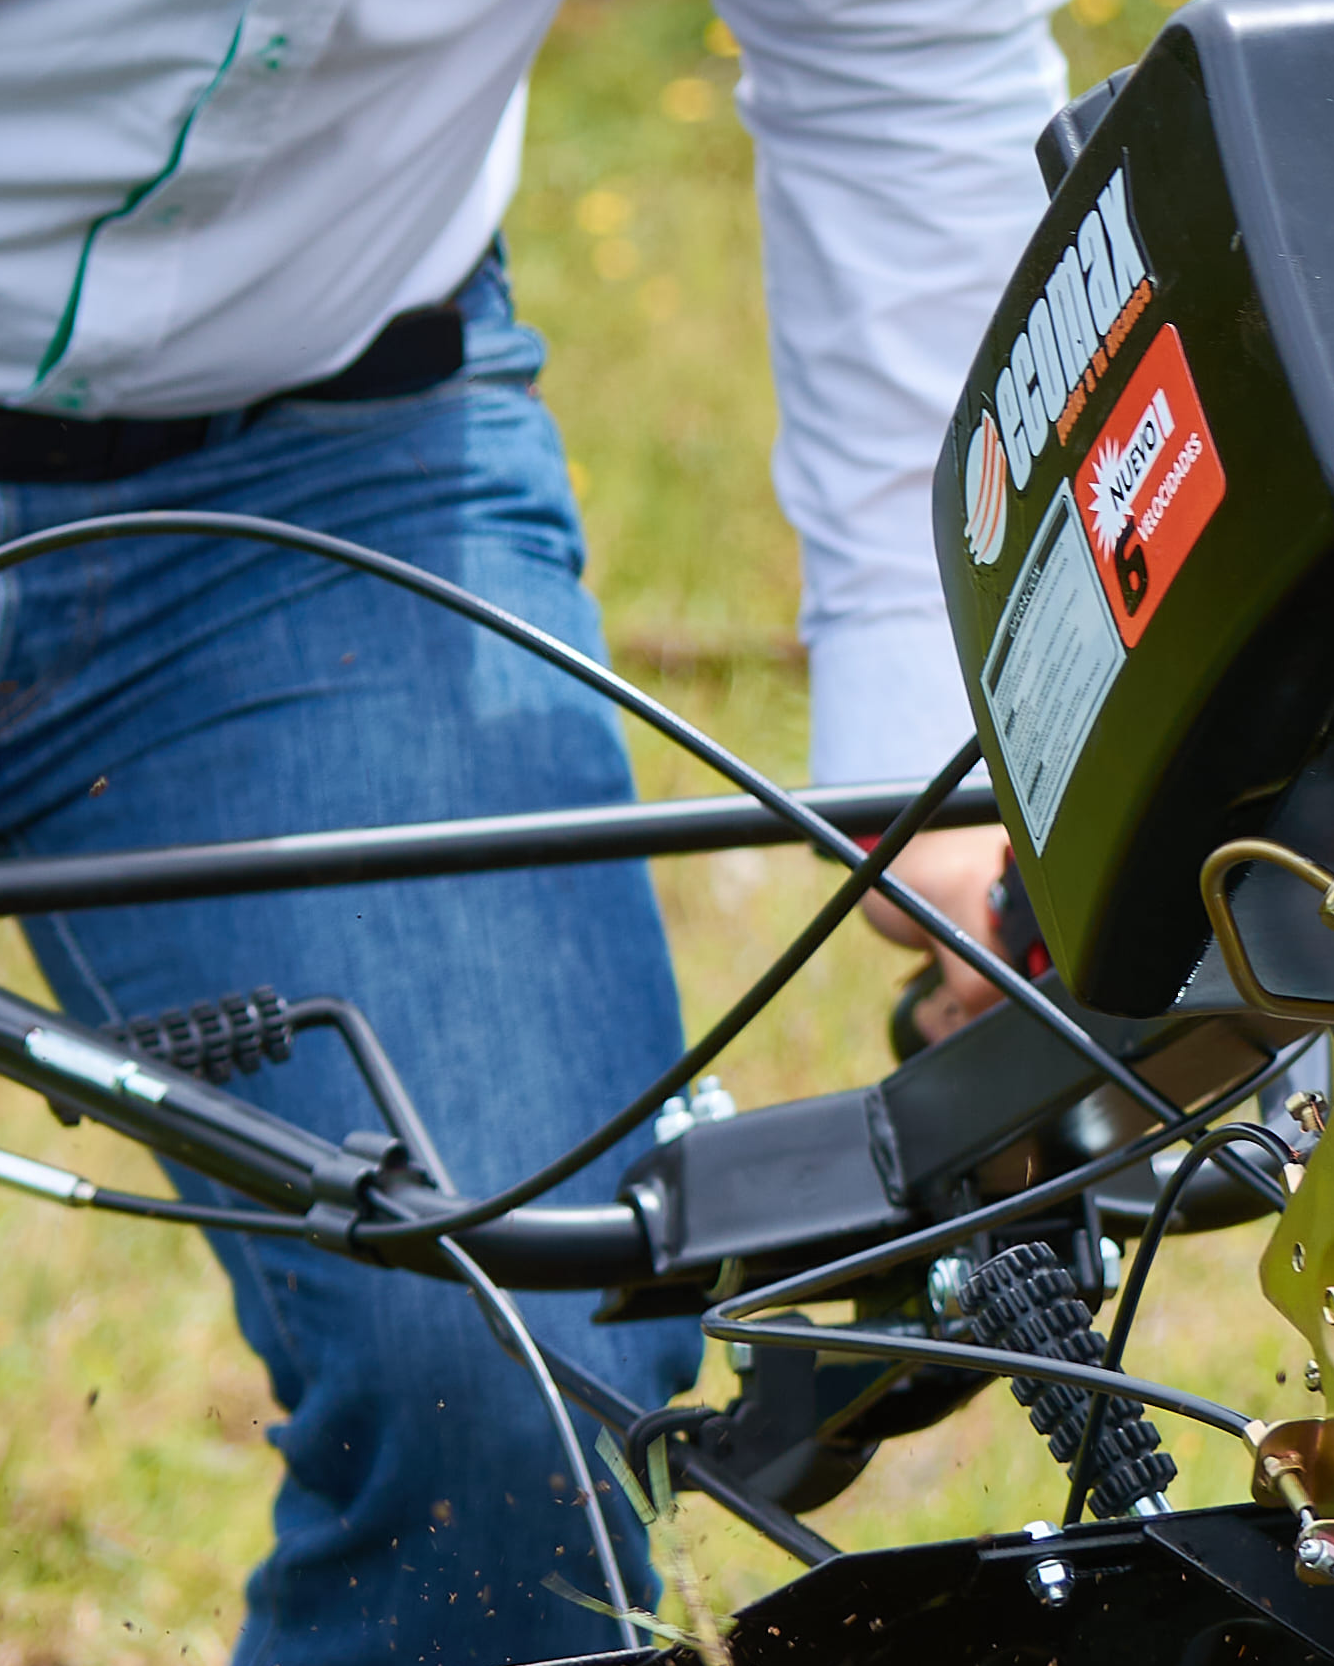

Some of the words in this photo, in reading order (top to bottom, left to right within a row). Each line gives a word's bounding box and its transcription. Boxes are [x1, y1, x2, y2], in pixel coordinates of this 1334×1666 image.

[995, 167, 1146, 492] ecomax
[1109, 419, 1156, 512] NUEVO
[1137, 432, 1202, 542] VELOCIDADES
[1114, 516, 1149, 617] 6
